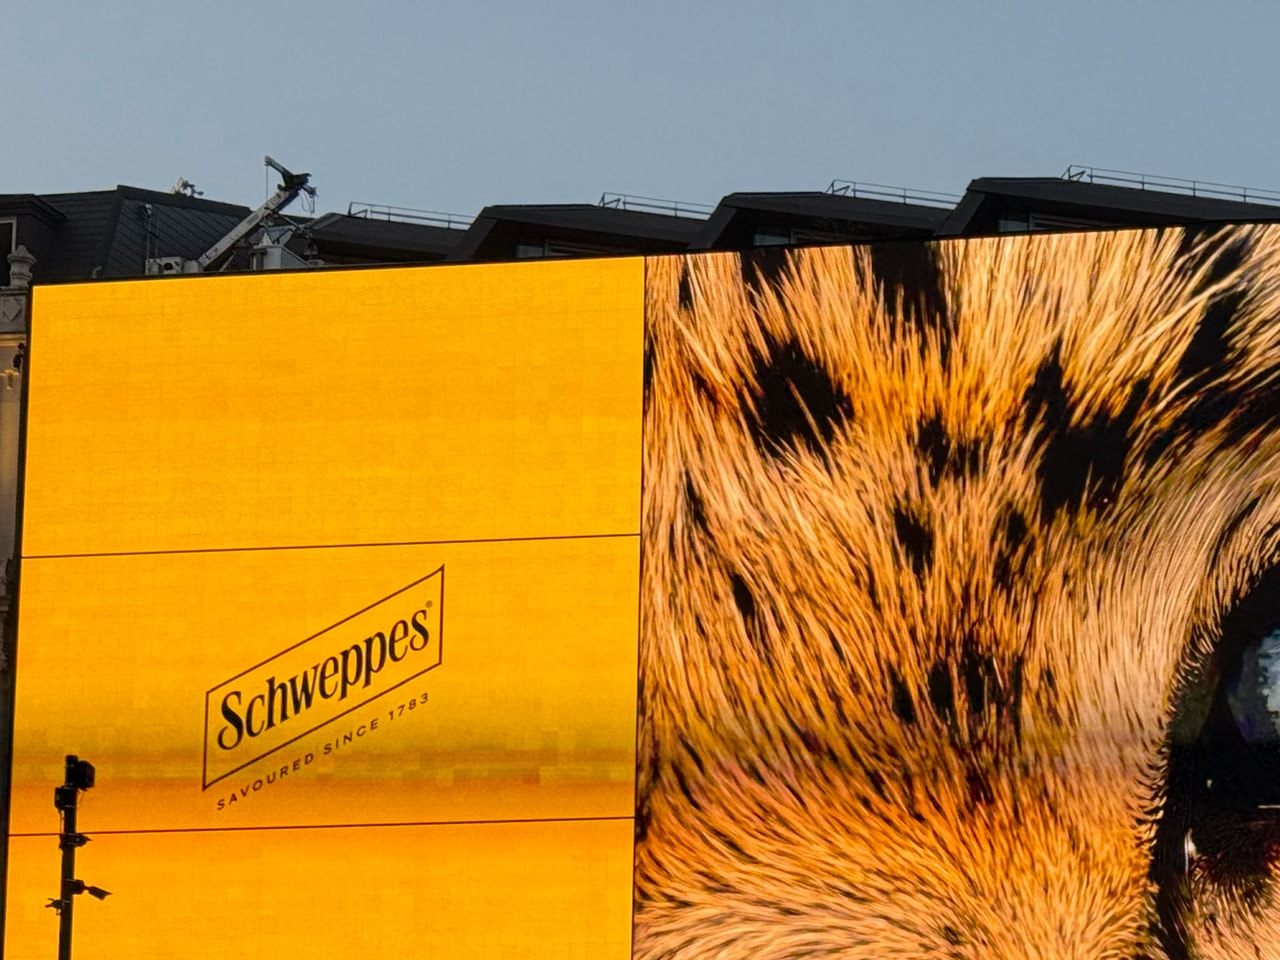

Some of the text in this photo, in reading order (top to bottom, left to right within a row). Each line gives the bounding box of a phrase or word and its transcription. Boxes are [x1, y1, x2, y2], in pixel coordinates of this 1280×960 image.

[216, 692, 430, 811] SAVOURED SINCE 1783
